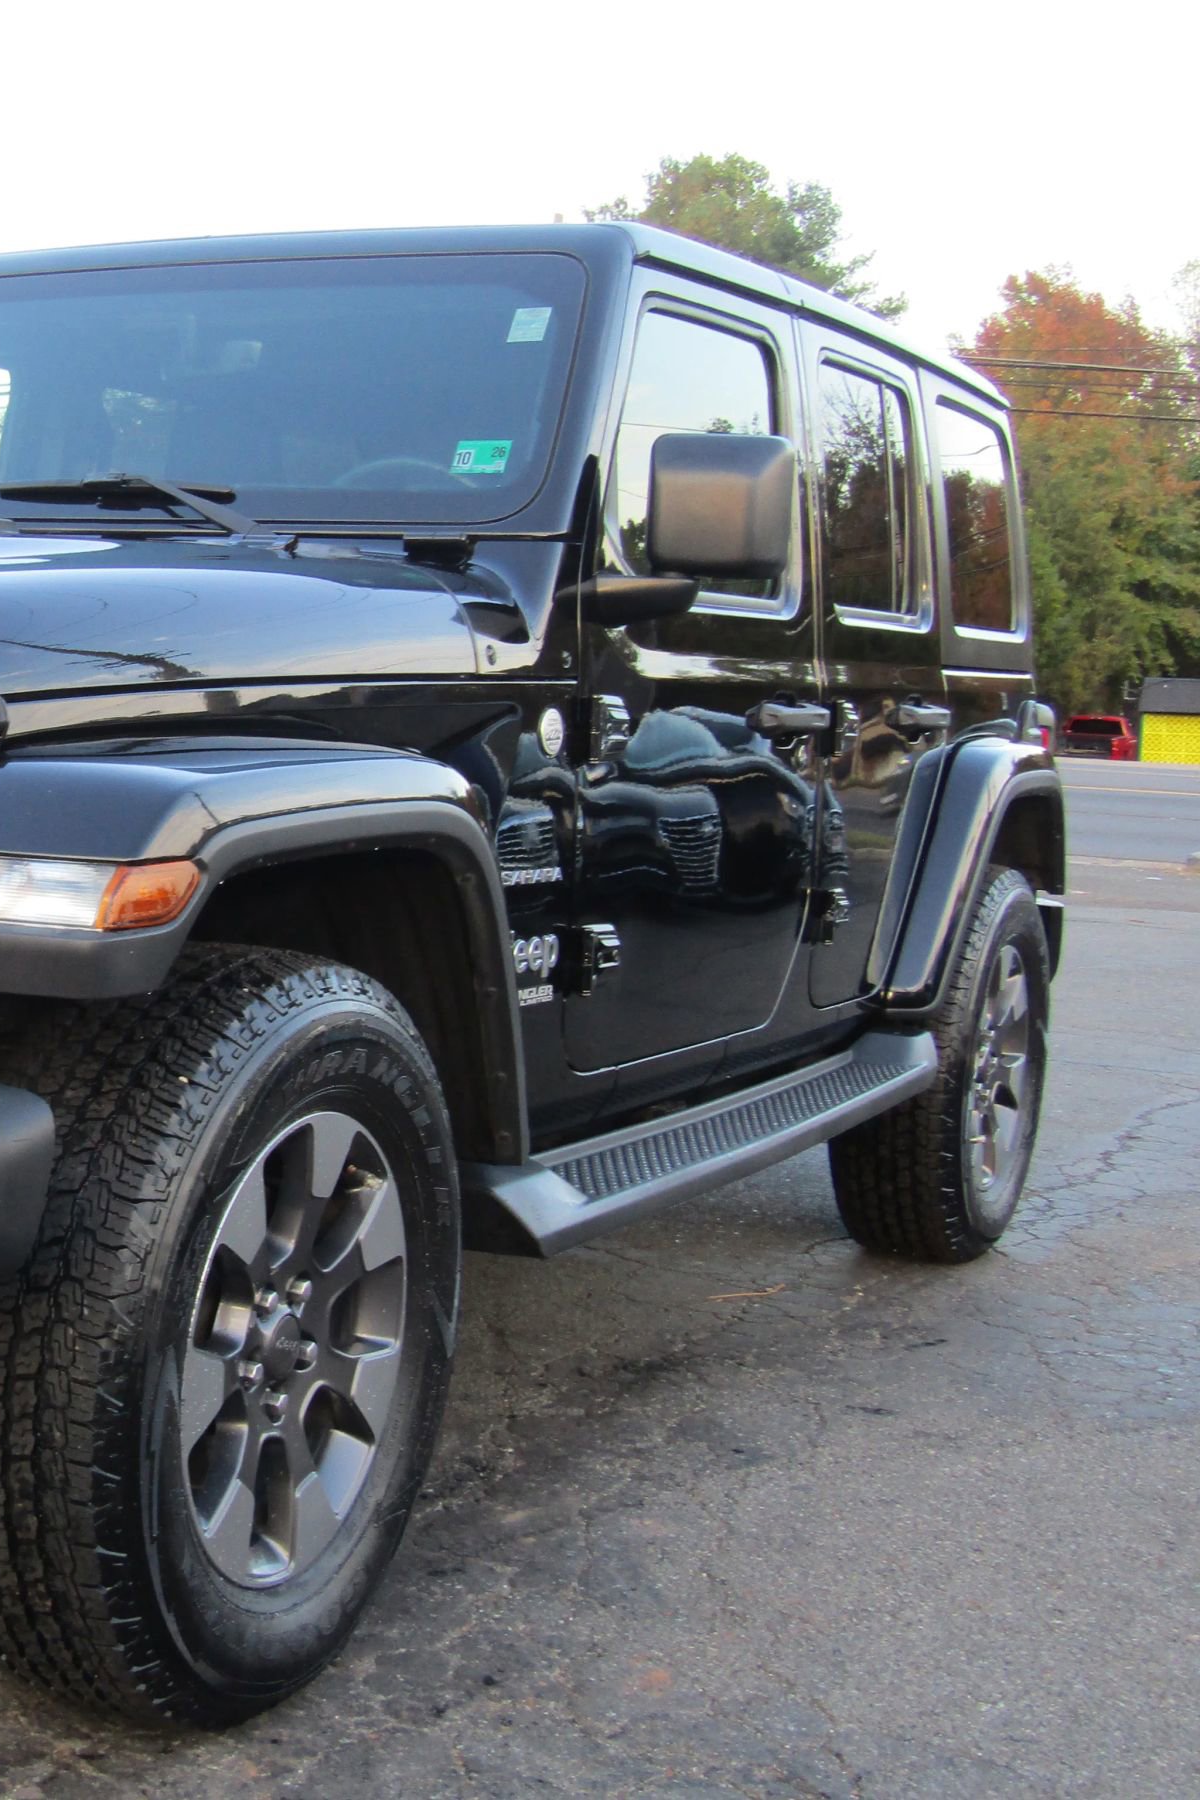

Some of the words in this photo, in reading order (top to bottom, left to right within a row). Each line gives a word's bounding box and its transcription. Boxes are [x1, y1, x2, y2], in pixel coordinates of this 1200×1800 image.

[456, 451, 471, 465] 10
[501, 867, 563, 886] SAHARA
[510, 929, 559, 978] eep
